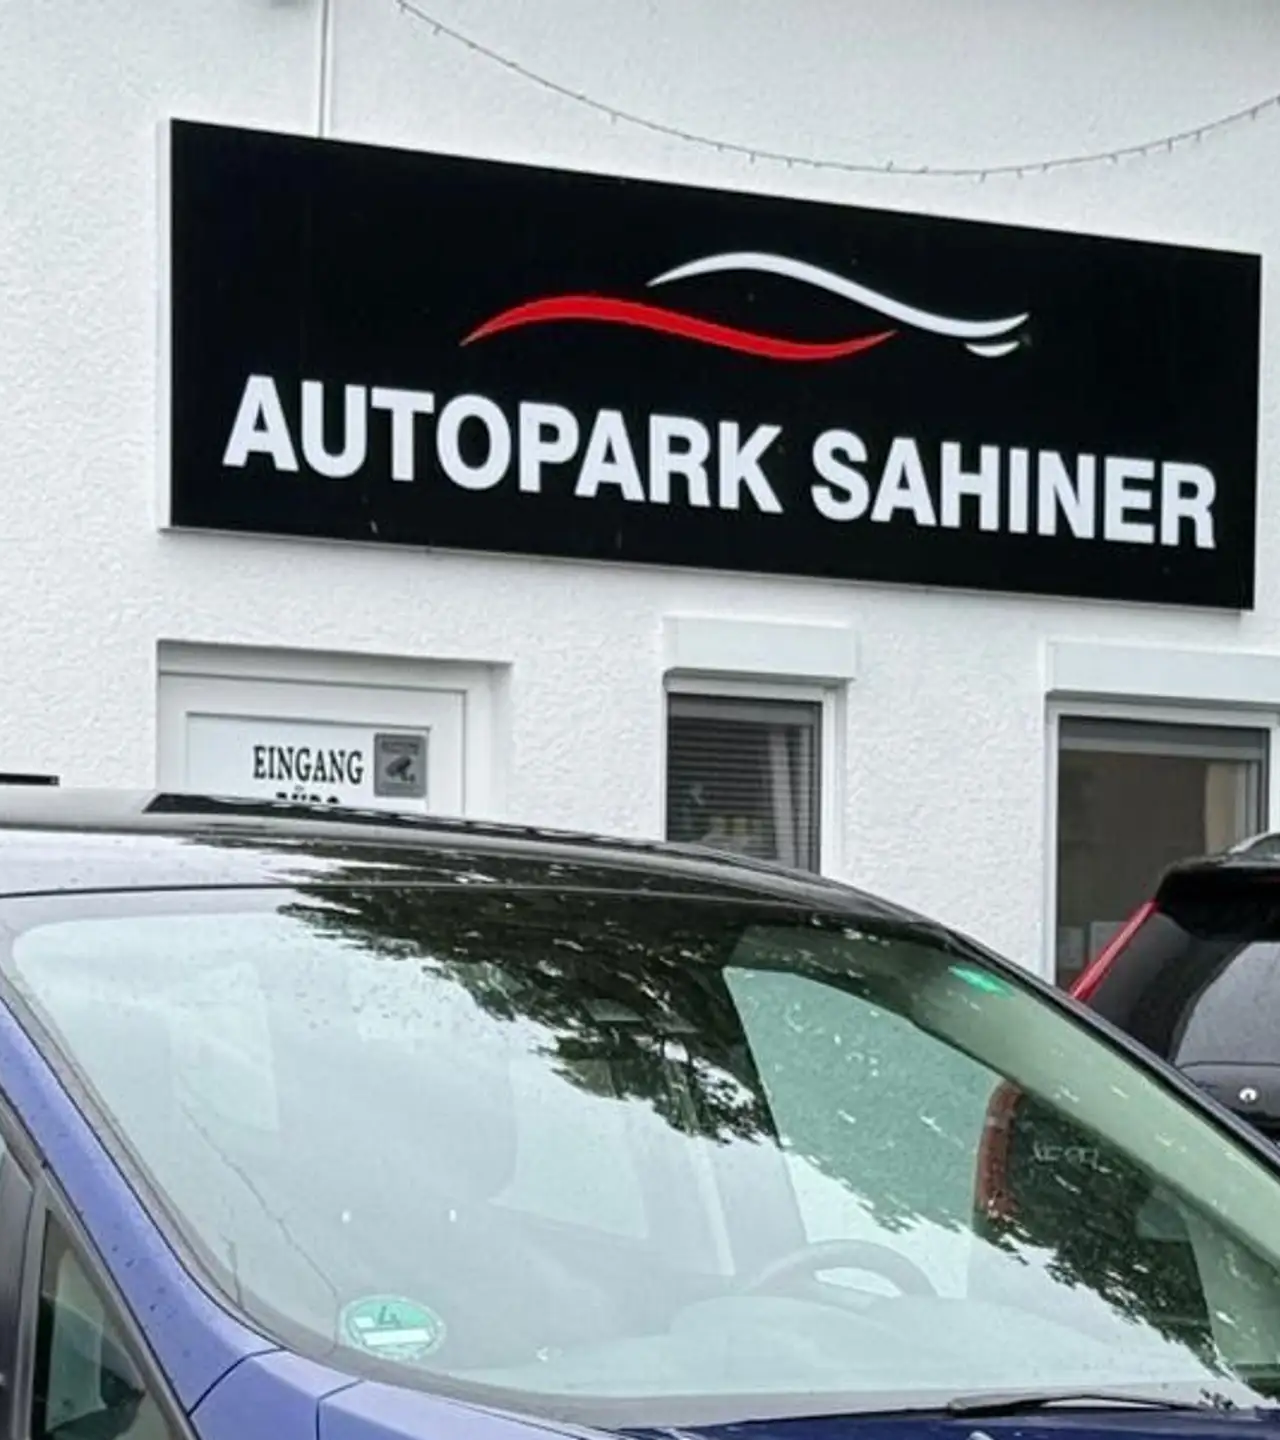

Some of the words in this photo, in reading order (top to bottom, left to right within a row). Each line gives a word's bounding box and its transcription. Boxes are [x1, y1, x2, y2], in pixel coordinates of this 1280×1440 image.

[222, 375, 782, 516] AUTOPARK
[811, 429, 1217, 549] SAHINER
[252, 744, 364, 785] EINGANG
